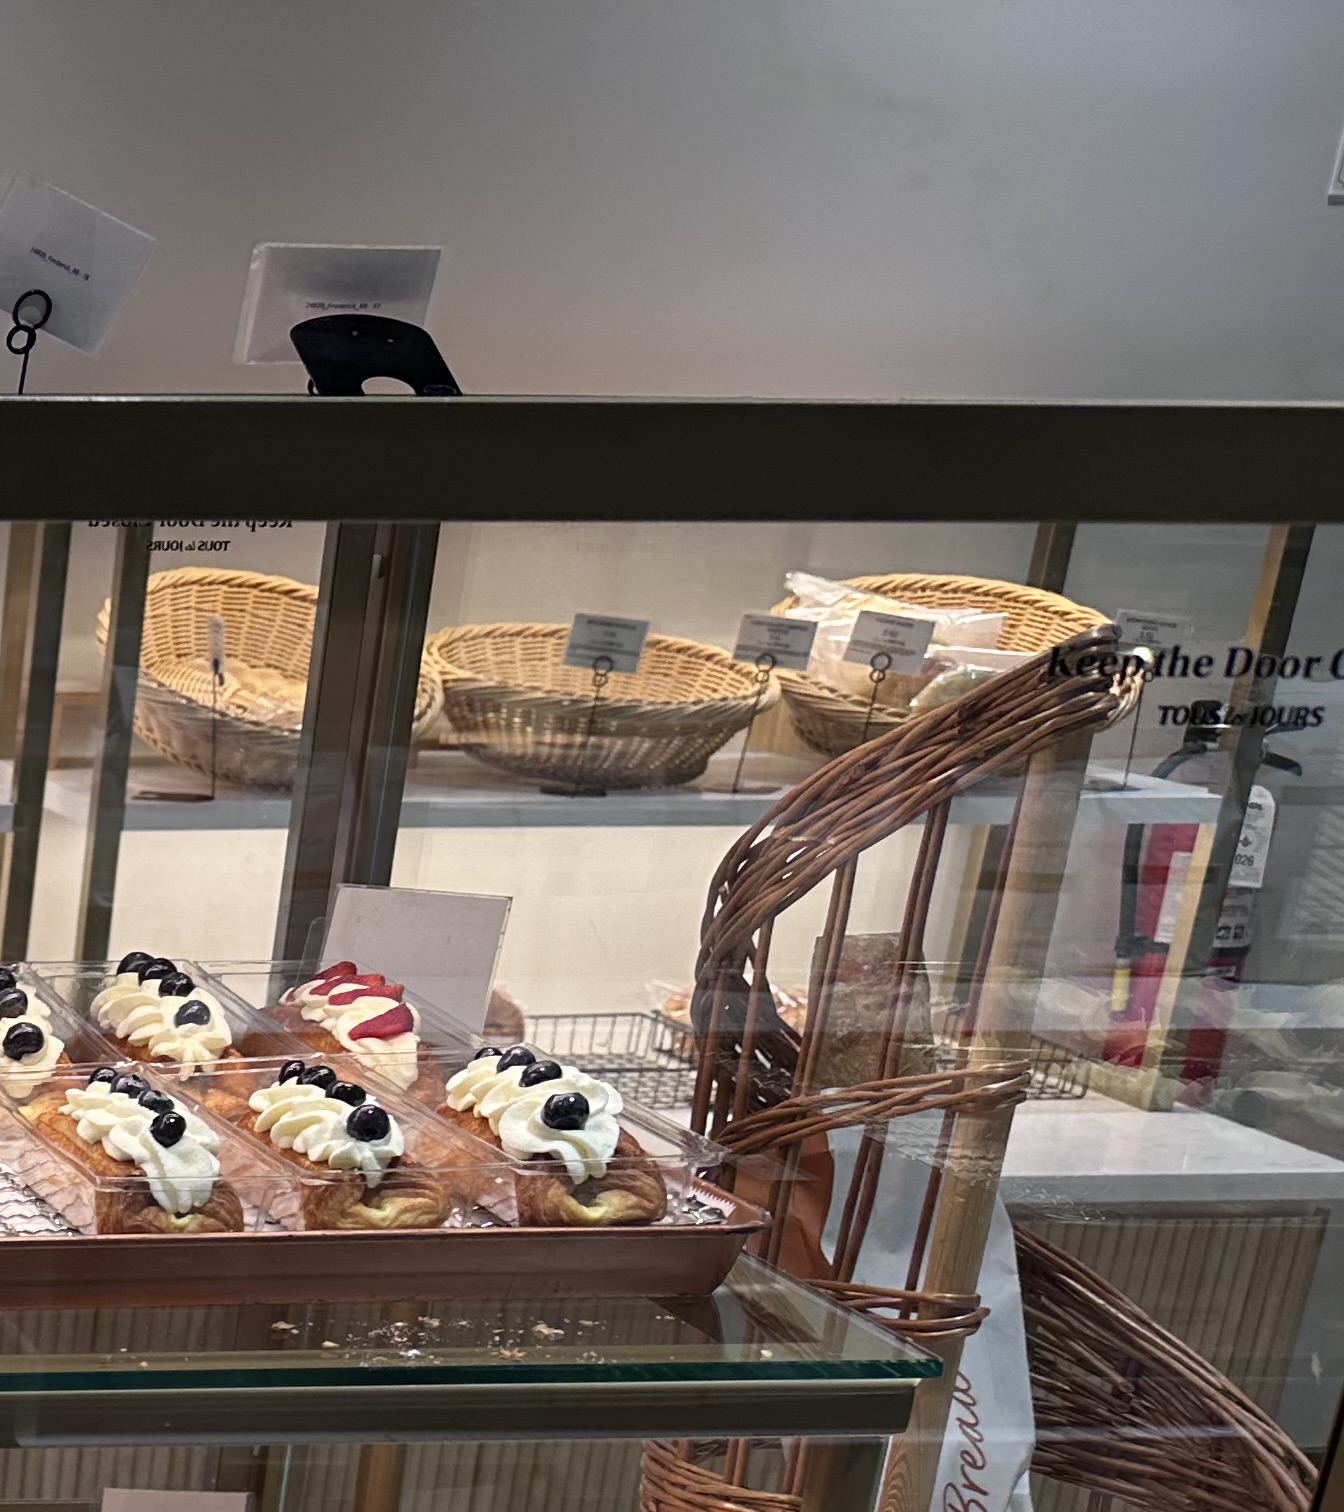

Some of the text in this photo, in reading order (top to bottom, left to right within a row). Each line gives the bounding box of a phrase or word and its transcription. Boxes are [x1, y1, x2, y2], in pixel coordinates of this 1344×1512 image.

[1047, 646, 1144, 684] Keep
[1154, 645, 1214, 679] the
[1224, 646, 1322, 679] Door
